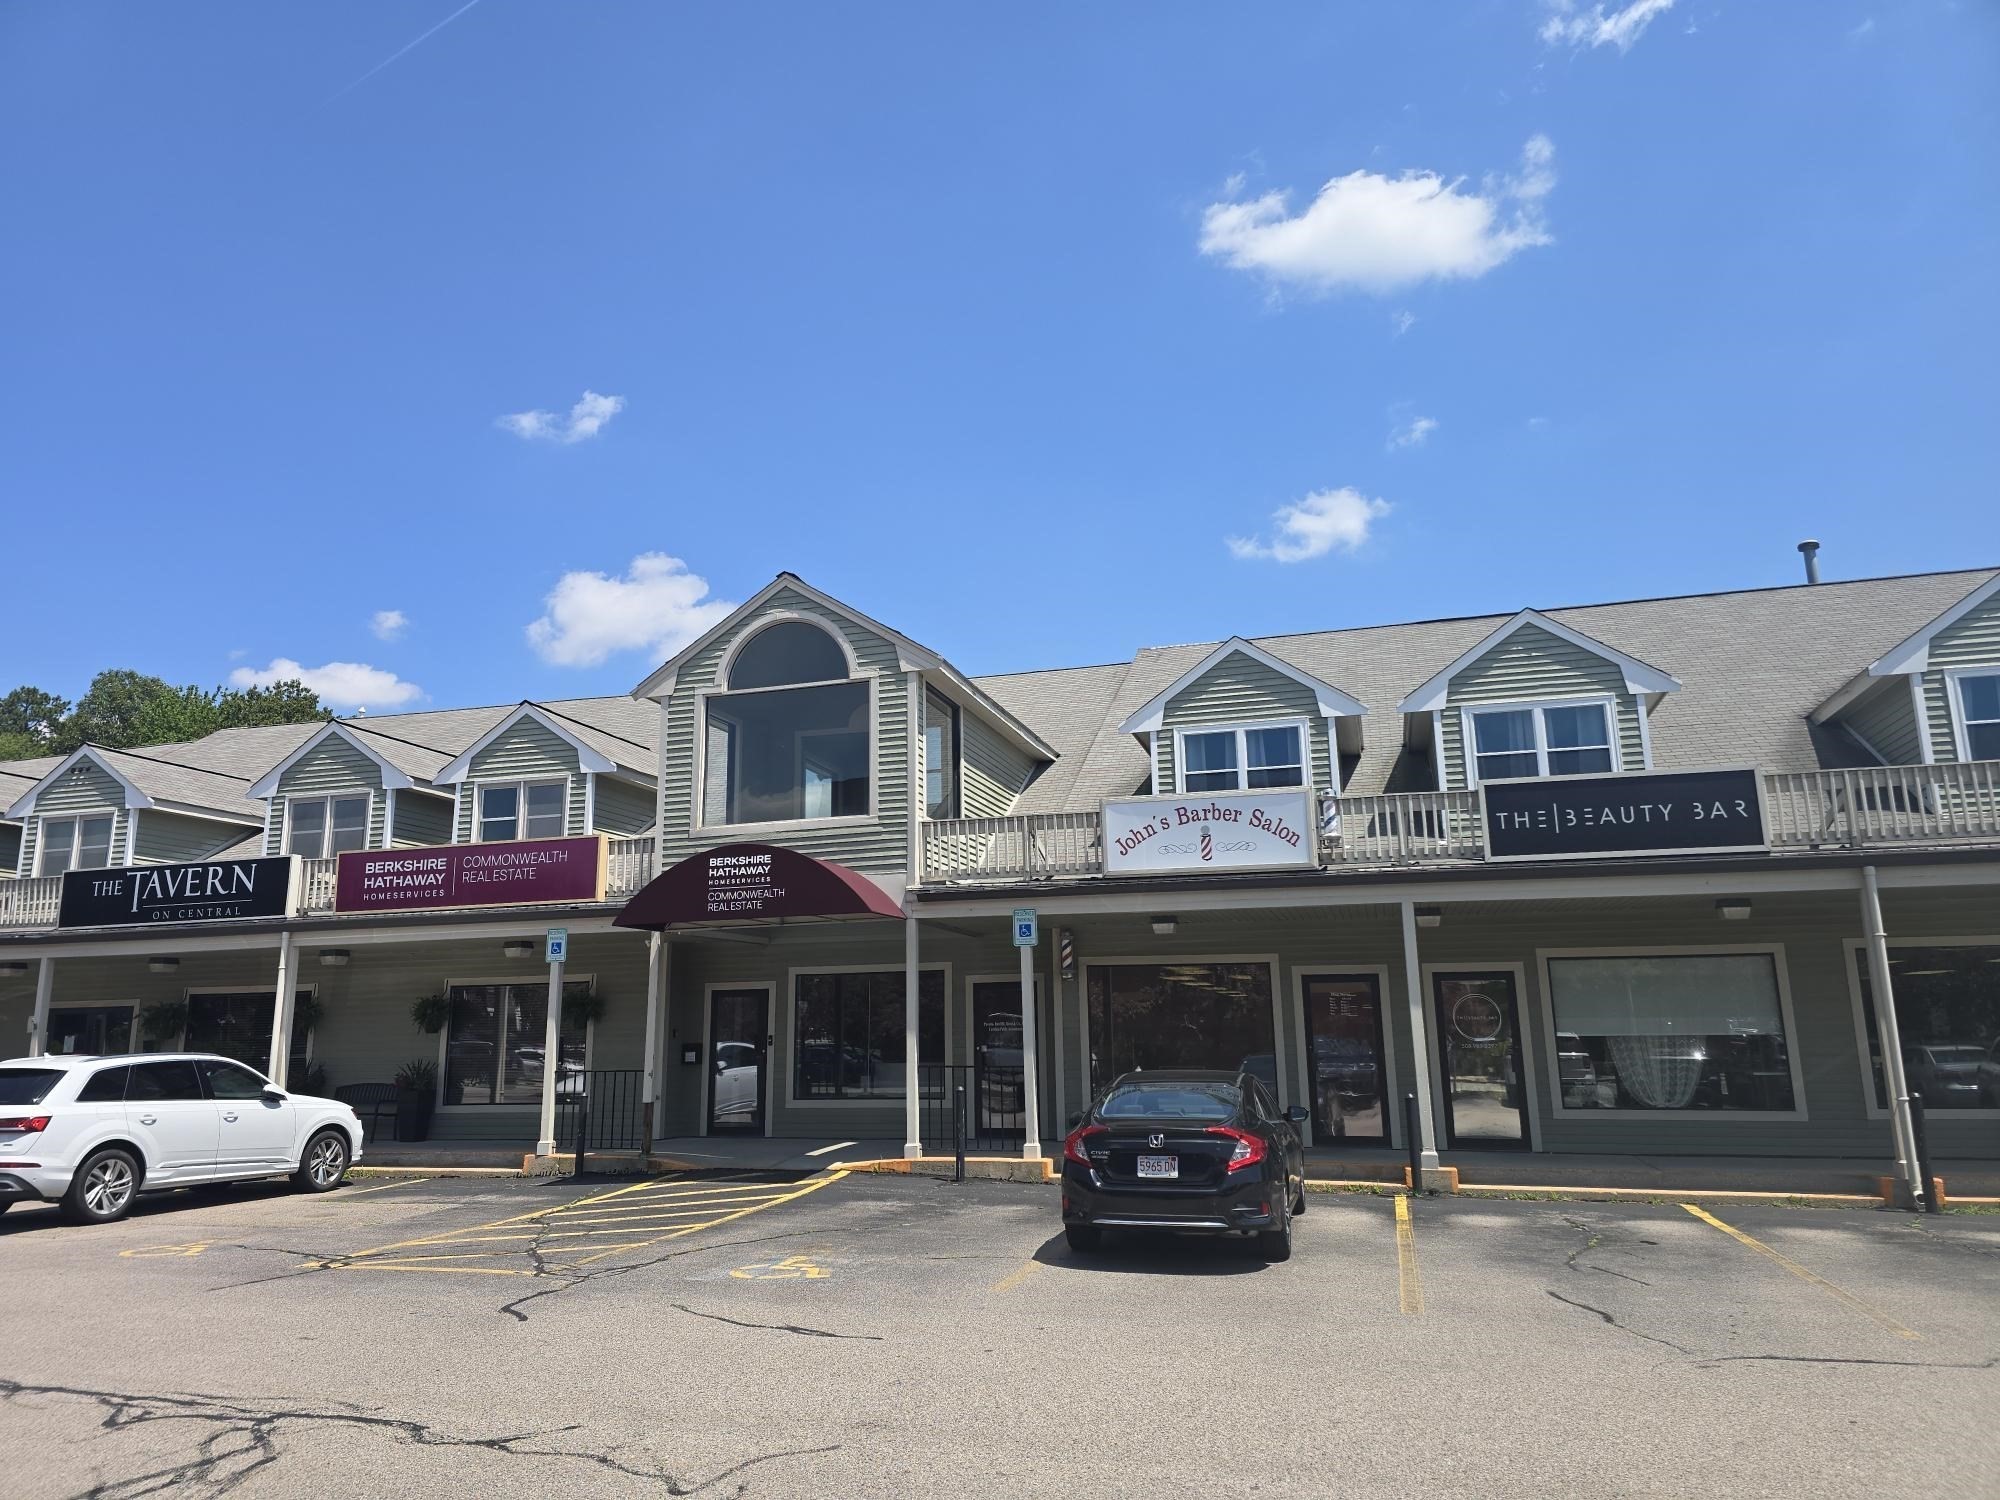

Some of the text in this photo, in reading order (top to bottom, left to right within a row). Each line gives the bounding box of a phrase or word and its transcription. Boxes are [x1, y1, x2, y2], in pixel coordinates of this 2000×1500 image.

[1692, 800, 1749, 820] BAR
[1115, 803, 1301, 857] John's Barber Salon
[365, 857, 448, 874] BERKSHIRE
[463, 850, 568, 869] COMMONWEALTH
[709, 854, 772, 867] BERKSHIRE
[462, 867, 537, 884] REAL ESTATE
[708, 865, 771, 877] HATHAWAY
[364, 872, 446, 889] HATHAWAY
[708, 876, 771, 886] HOMESERVICES
[92, 863, 258, 913] THE TAVERN
[363, 888, 445, 901] HOMESERVICES
[707, 888, 785, 901] COMMONWEALTH
[152, 906, 241, 920] ON CENTRAL
[707, 900, 763, 912] REAL ESTATE
[1139, 1160, 1162, 1172] 5965
